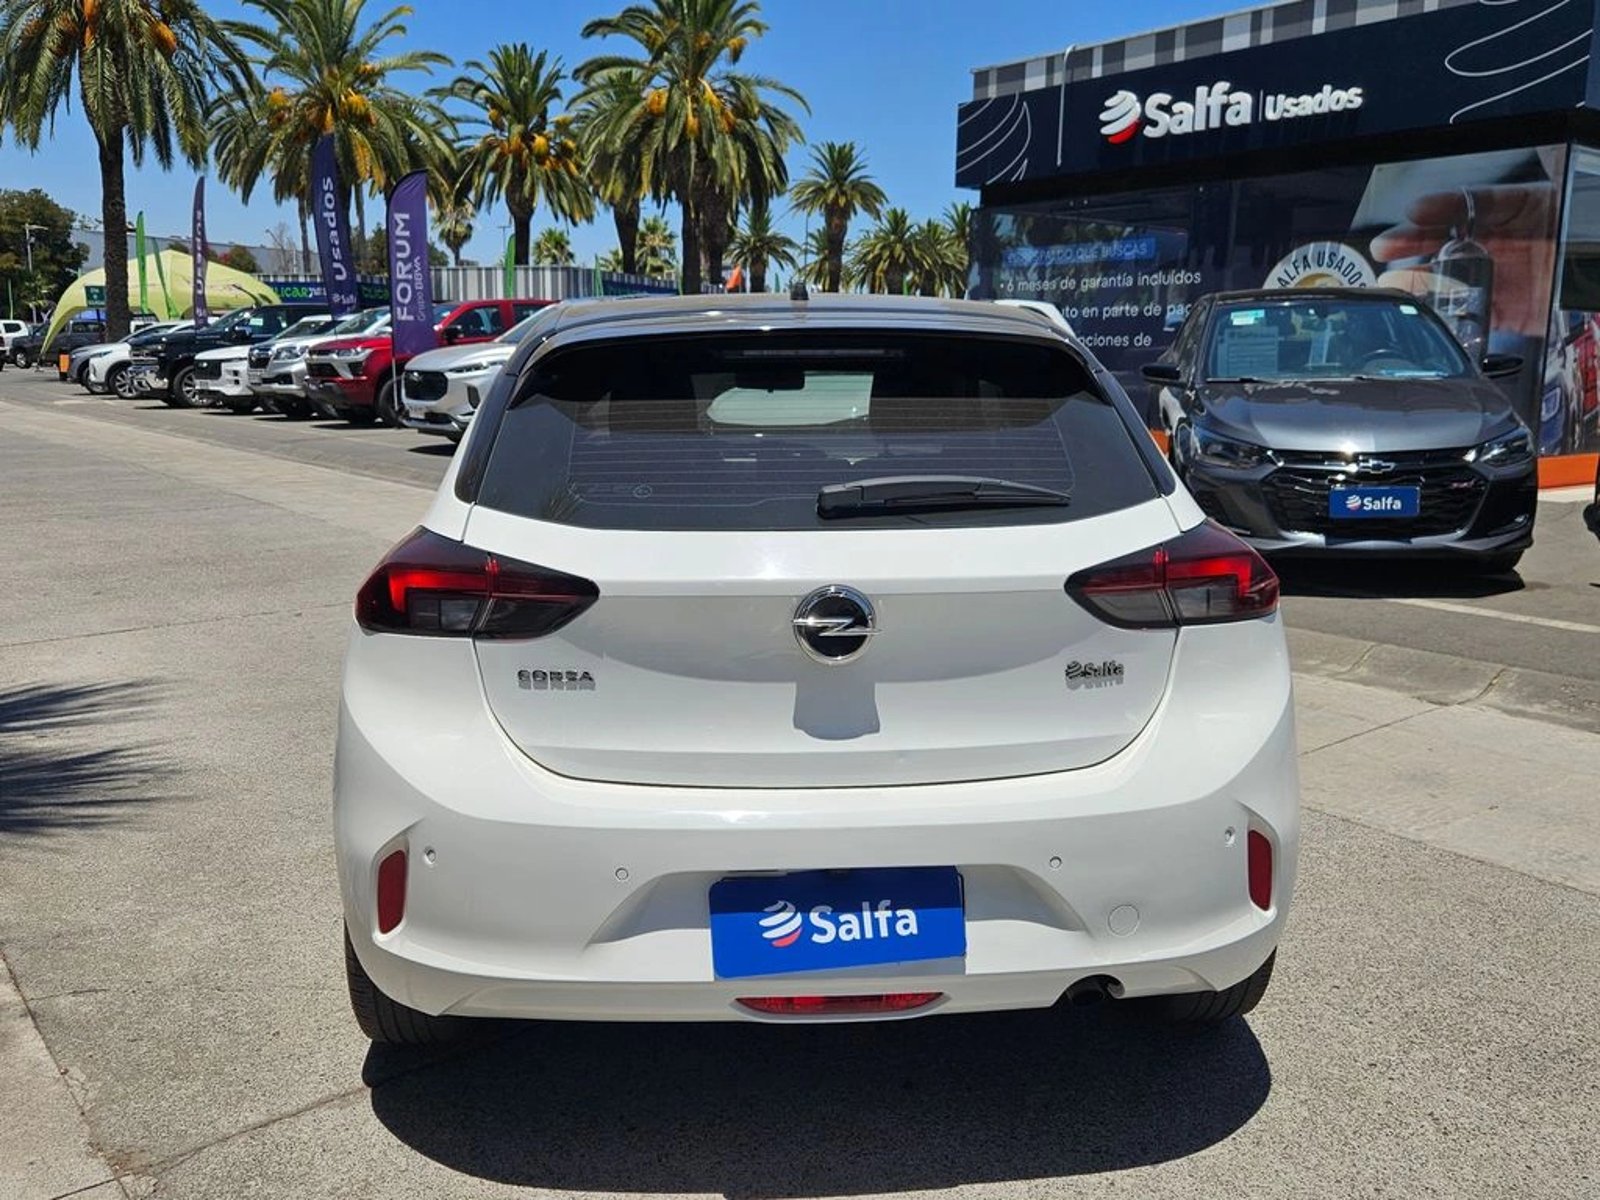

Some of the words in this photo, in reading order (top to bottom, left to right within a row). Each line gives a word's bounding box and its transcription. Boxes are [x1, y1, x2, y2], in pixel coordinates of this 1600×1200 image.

[1143, 81, 1252, 138] Salfa
[1264, 84, 1363, 121] Usados
[322, 176, 347, 281] Usados
[393, 212, 415, 321] FORUM
[1276, 255, 1312, 288] ALFA
[1017, 279, 1057, 291] meses
[1060, 275, 1076, 290] de
[1082, 306, 1099, 318] en
[1102, 302, 1139, 319] parte
[1143, 301, 1162, 316] de
[1077, 332, 1129, 347] pciones
[1133, 331, 1152, 346] de
[1363, 496, 1402, 511] Salfa
[517, 669, 595, 683] CORSA
[1083, 660, 1124, 678] Salfa
[808, 899, 919, 944] Salfa
